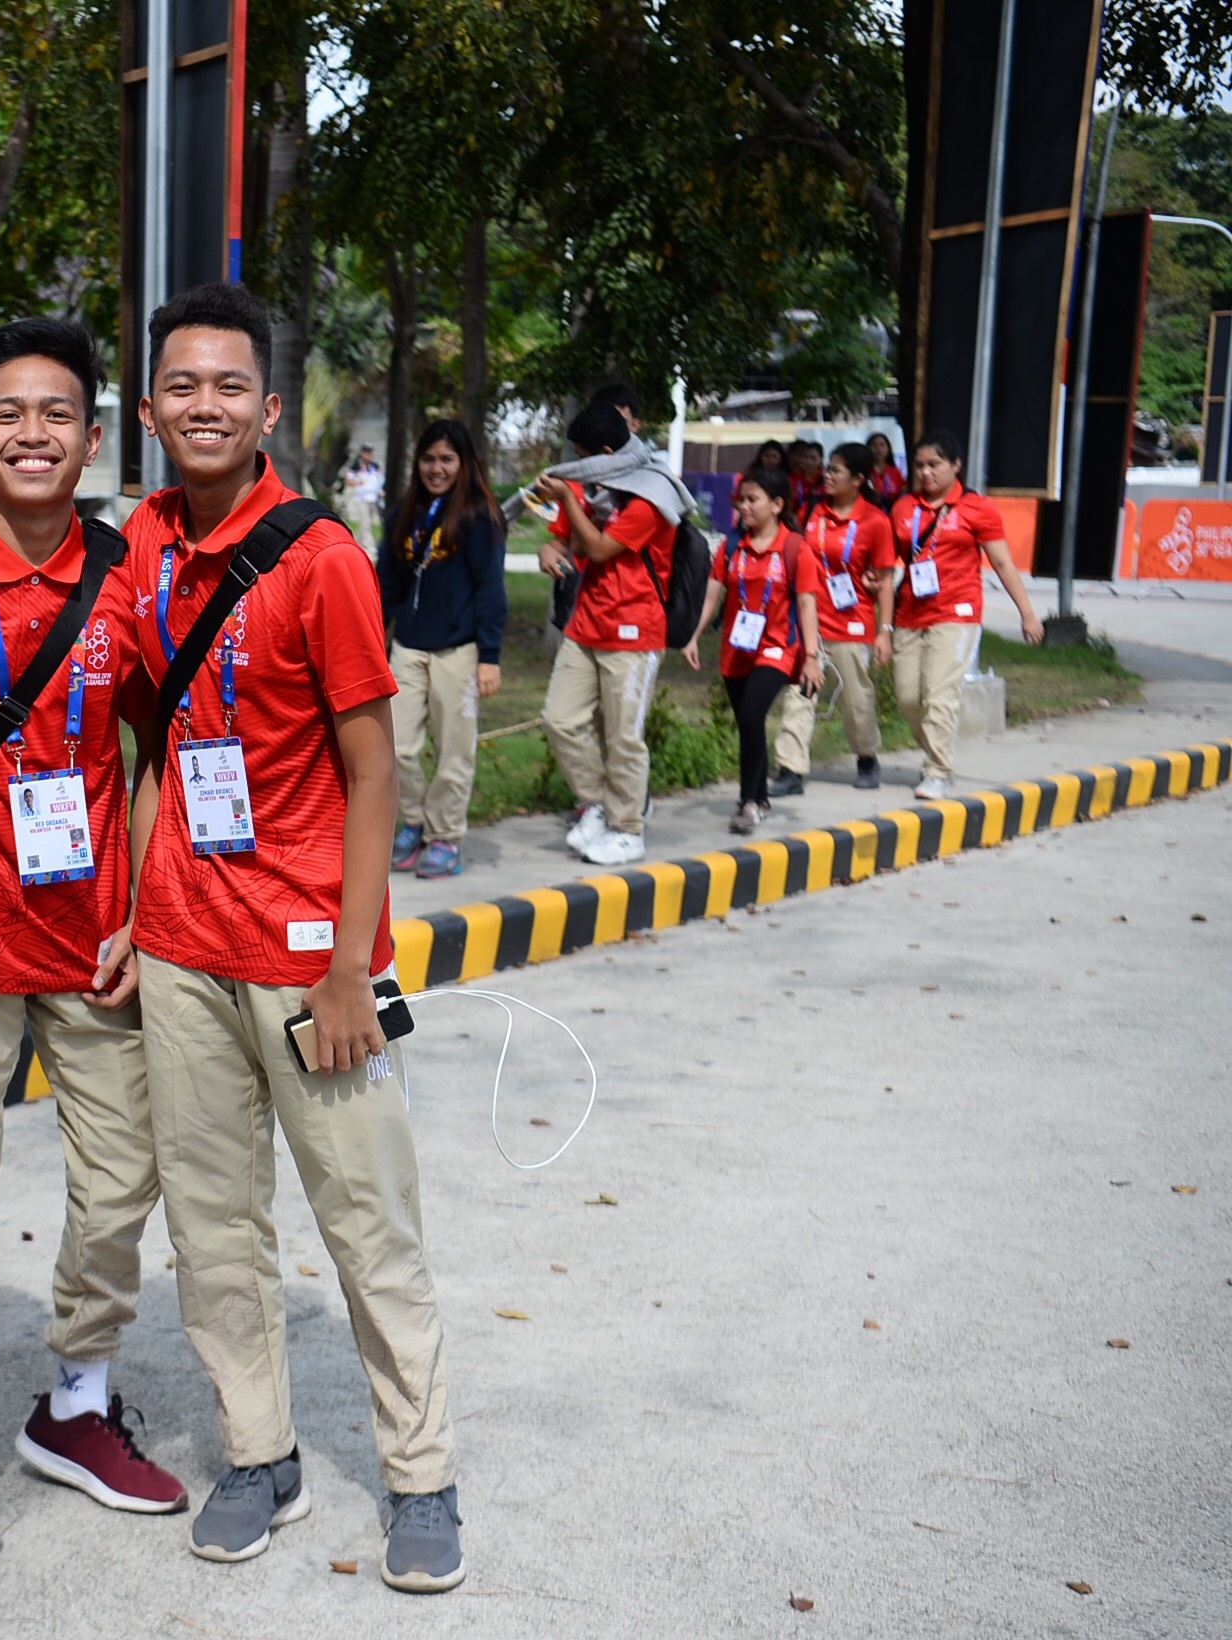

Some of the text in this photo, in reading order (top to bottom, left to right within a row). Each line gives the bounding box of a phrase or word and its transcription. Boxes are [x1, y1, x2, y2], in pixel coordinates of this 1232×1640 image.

[162, 558, 172, 571] AS
[158, 573, 170, 592] ONE
[52, 802, 74, 812] WKFV
[367, 1057, 392, 1081] ONE
